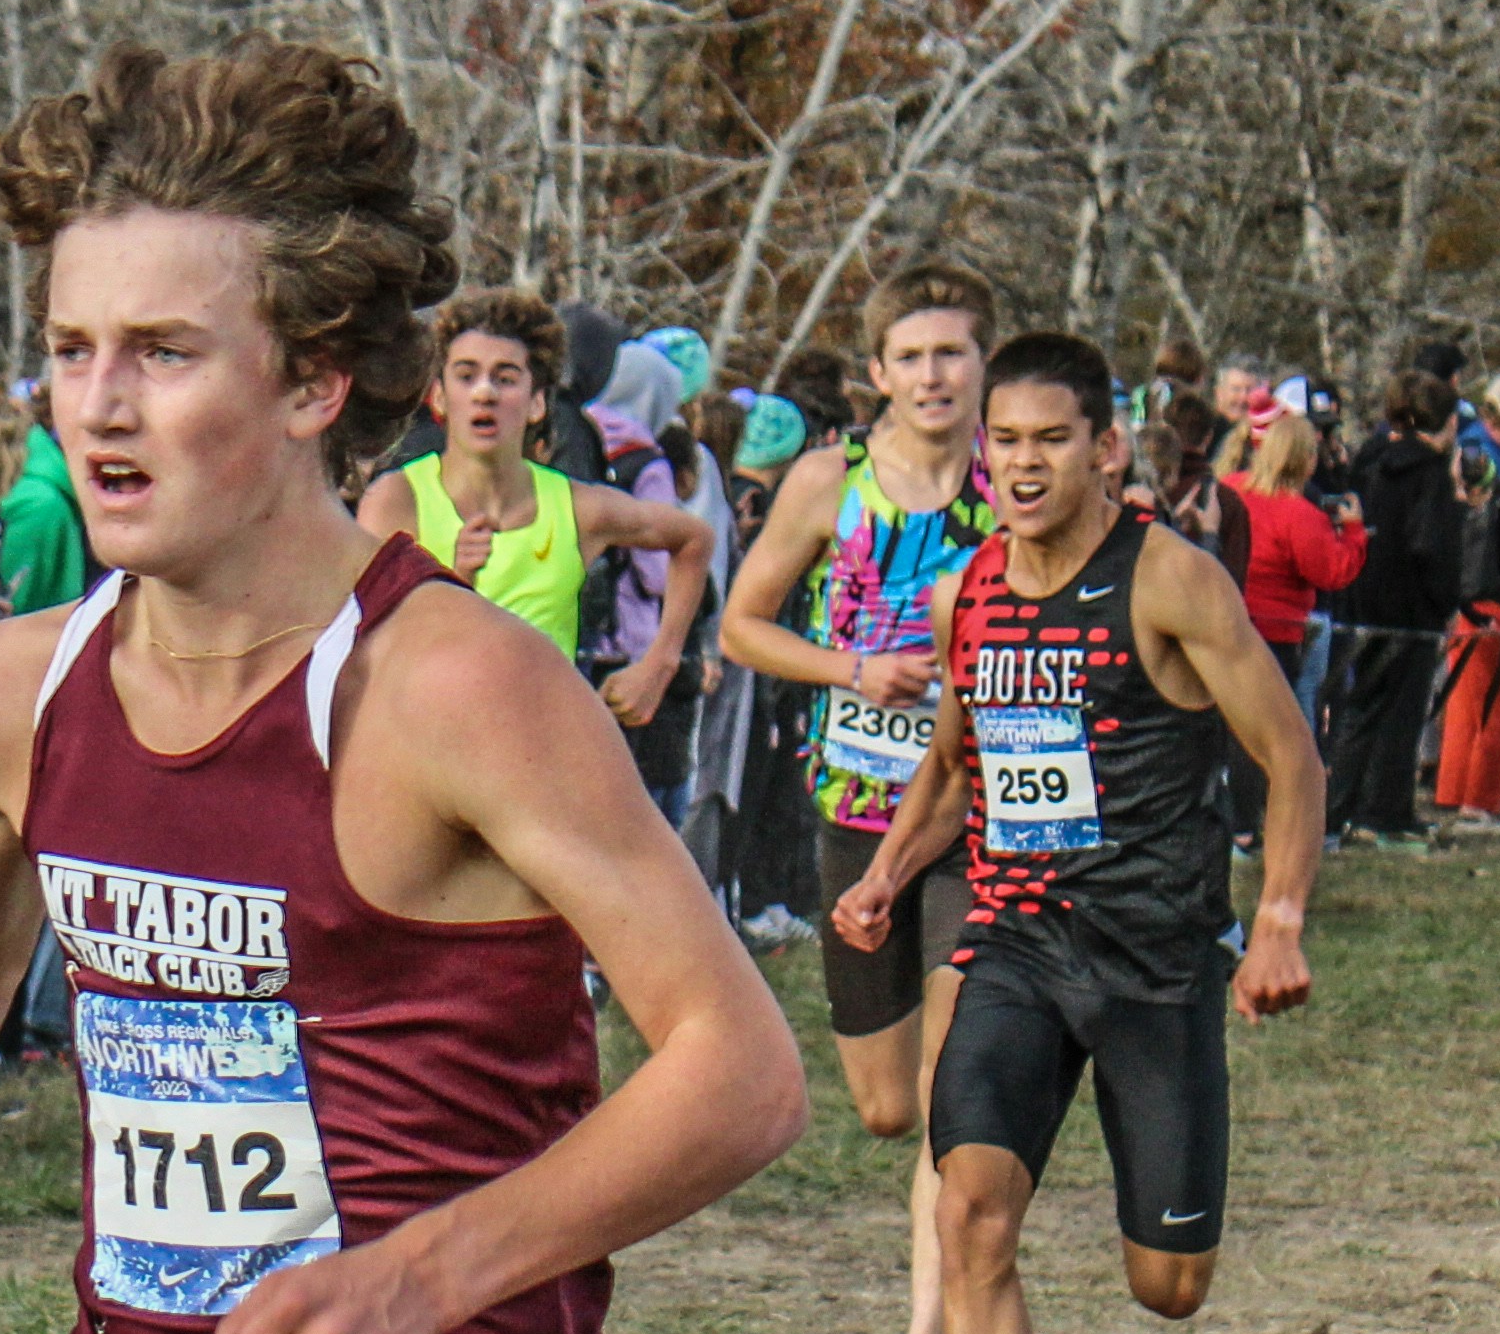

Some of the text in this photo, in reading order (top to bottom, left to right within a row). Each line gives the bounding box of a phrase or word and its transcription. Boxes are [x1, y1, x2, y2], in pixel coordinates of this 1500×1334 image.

[973, 647, 1086, 705] BOISE
[838, 701, 936, 747] 2309
[997, 767, 1070, 805] 259
[38, 864, 287, 957] MT TABOR
[157, 953, 247, 997] CLUB
[84, 1035, 284, 1079] NORTHWEST
[151, 1079, 192, 1097] 2023
[112, 1126, 298, 1214] 1712
